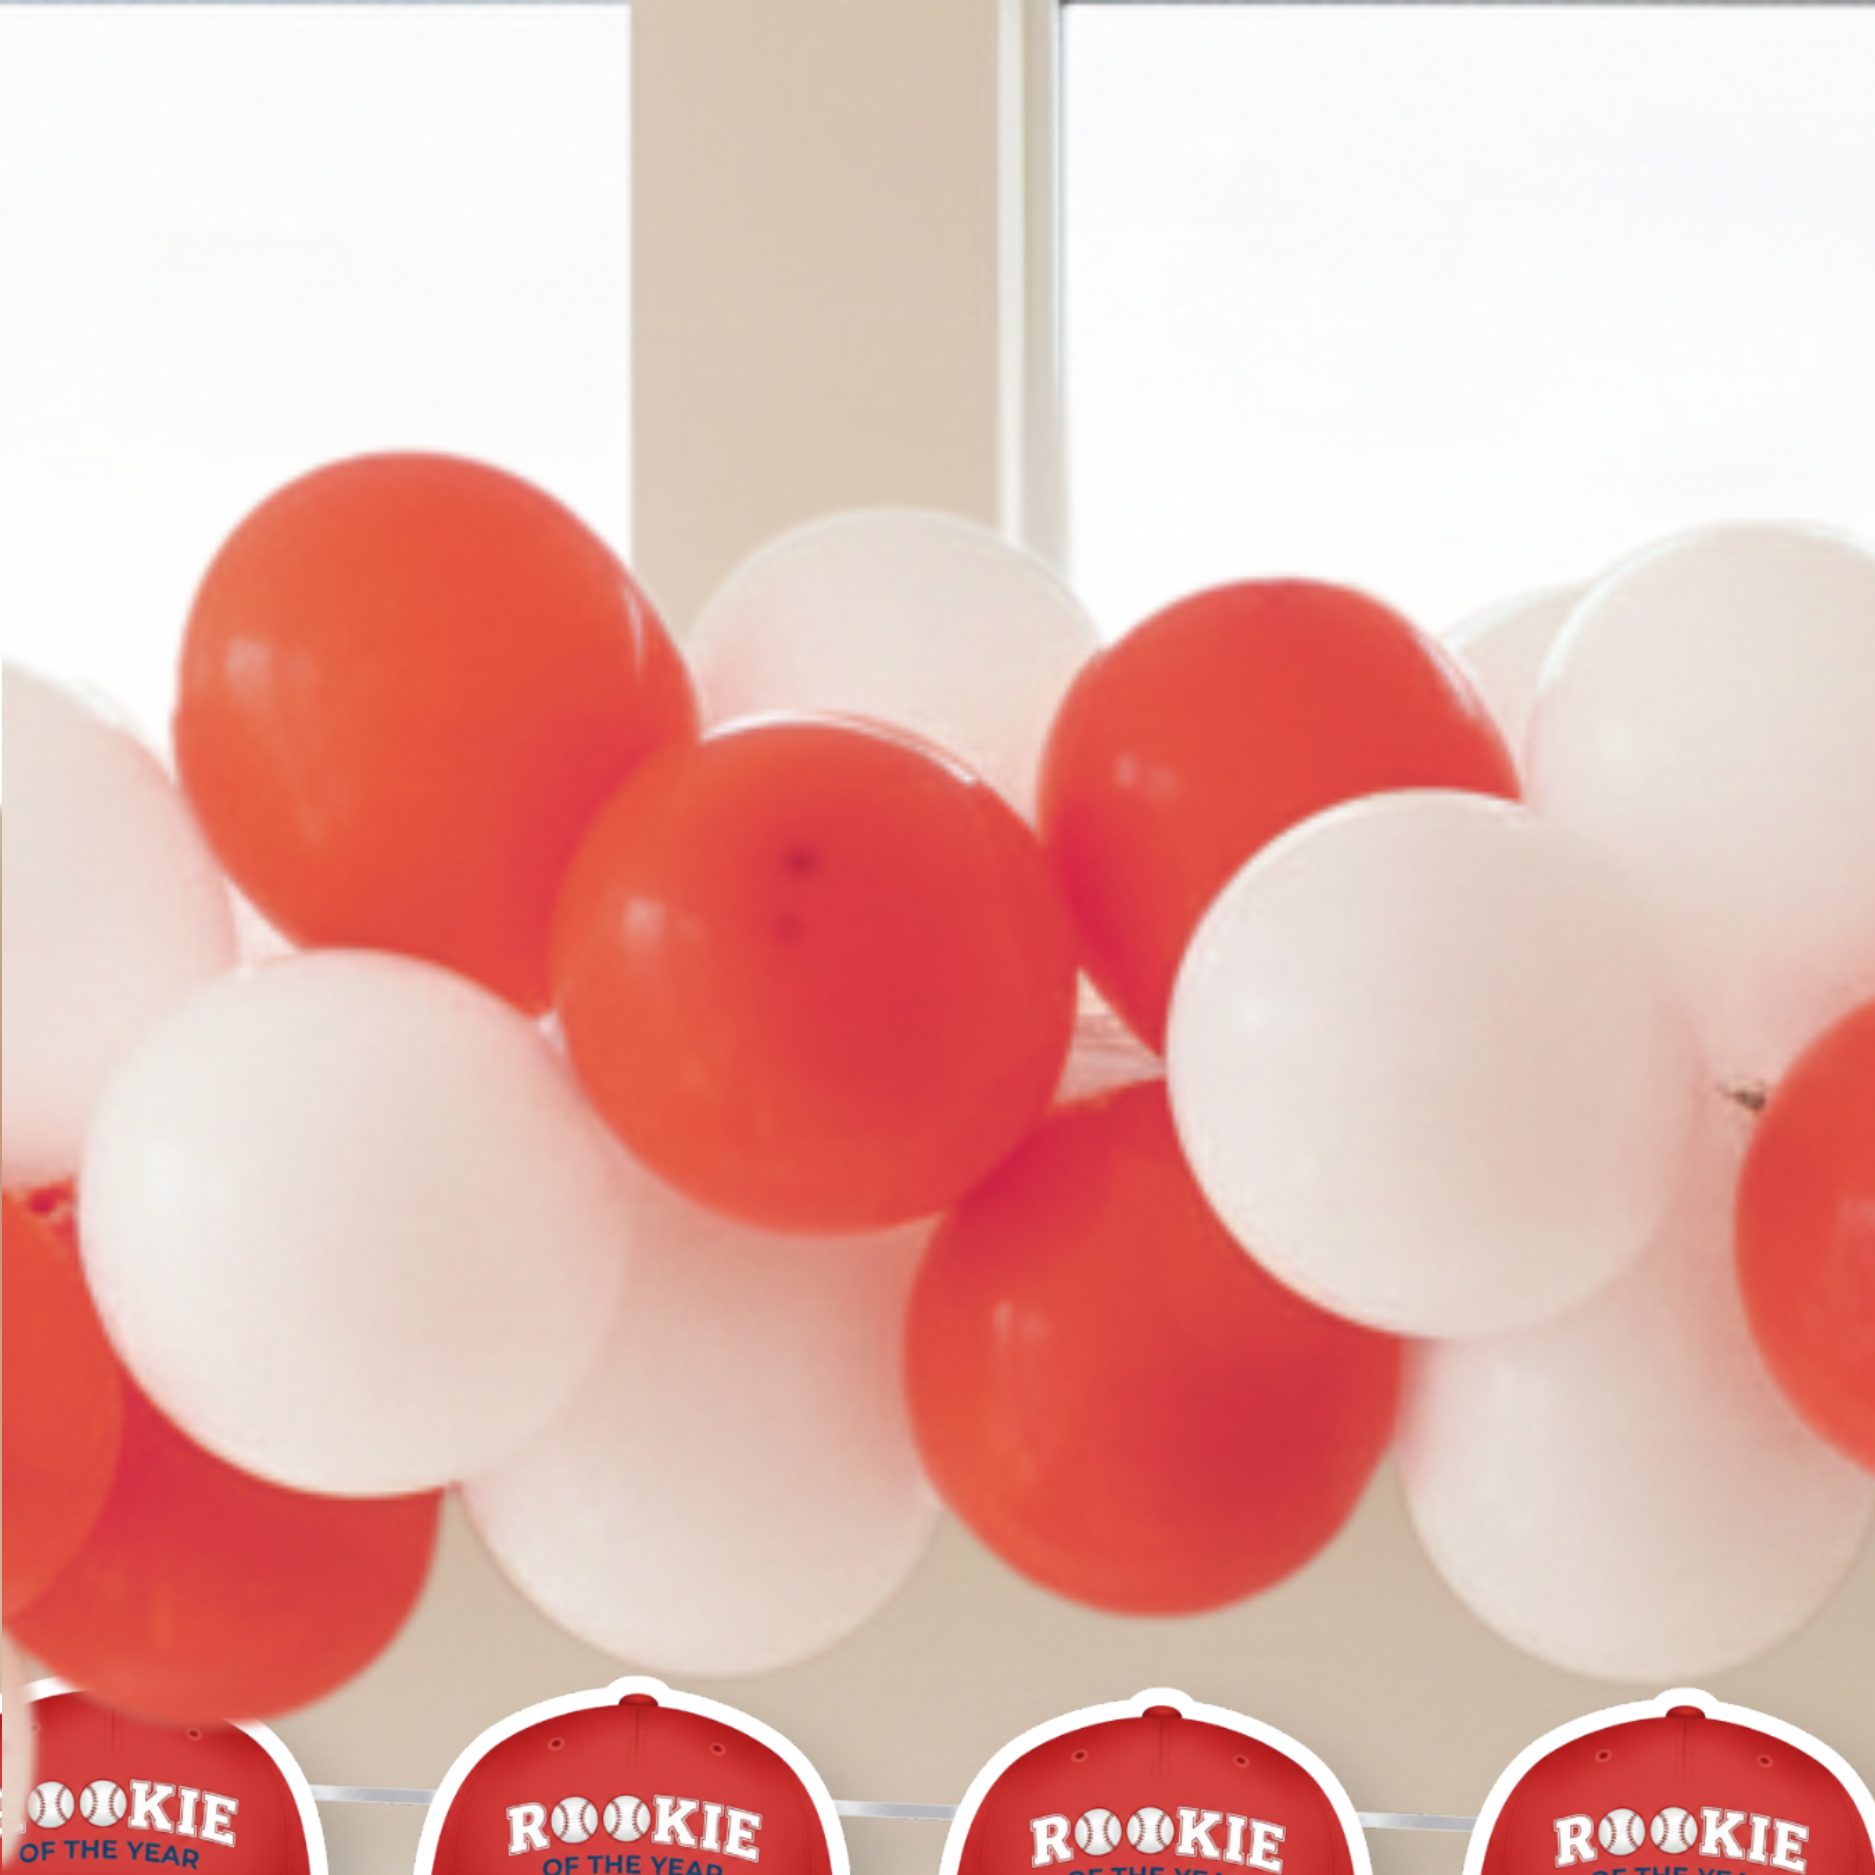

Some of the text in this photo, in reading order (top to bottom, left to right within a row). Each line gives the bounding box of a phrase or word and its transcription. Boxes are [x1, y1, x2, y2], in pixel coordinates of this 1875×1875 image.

[14, 1778, 239, 1848] OOKIE
[505, 1794, 762, 1863] ROOKIE
[1029, 1806, 1287, 1875] ROOKIE
[1553, 1806, 1810, 1875] ROOKIE
[18, 1839, 200, 1870] OF THE YEAR
[587, 1854, 642, 1875] THE
